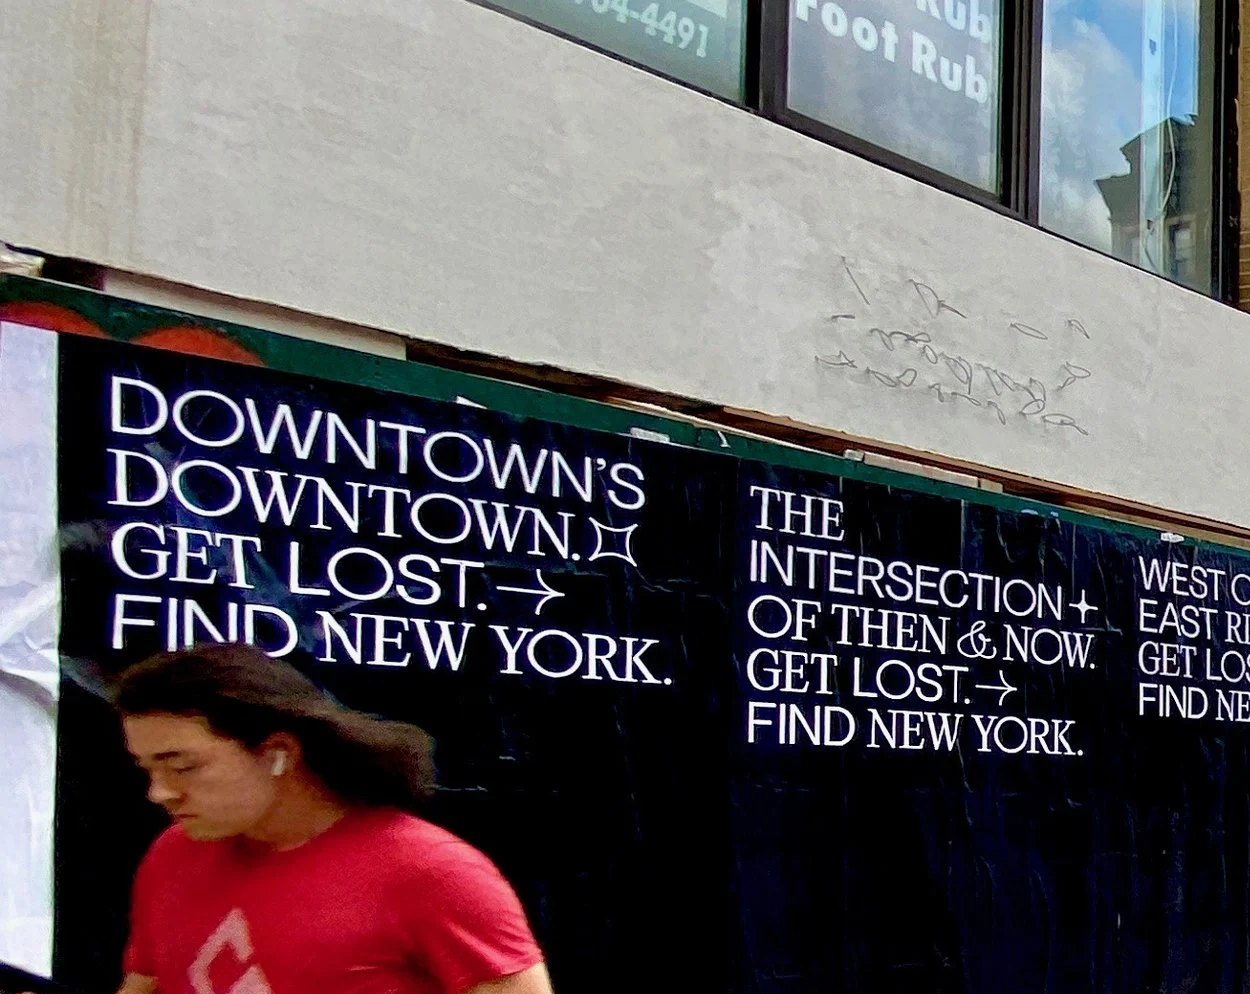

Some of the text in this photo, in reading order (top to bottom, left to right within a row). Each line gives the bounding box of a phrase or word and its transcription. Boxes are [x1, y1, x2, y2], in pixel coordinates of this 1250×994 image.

[912, 31, 988, 104] Rub
[110, 375, 646, 511] DOWNTOWN'S
[106, 447, 581, 563] DOWNTOWN.
[750, 485, 845, 541] THE
[110, 521, 488, 611] GET LOST.
[750, 540, 1063, 620] INTERSECTION
[1138, 555, 1227, 601] WEST
[112, 593, 674, 687] FIND NEW YORK.
[747, 594, 1096, 669] OF THEN & NOW.
[1138, 598, 1218, 640] EAST
[747, 648, 972, 705] GET LOST.
[1137, 641, 1202, 679] GET
[748, 701, 1084, 757] FIND NEW YORK.
[1138, 682, 1209, 719] FIND
